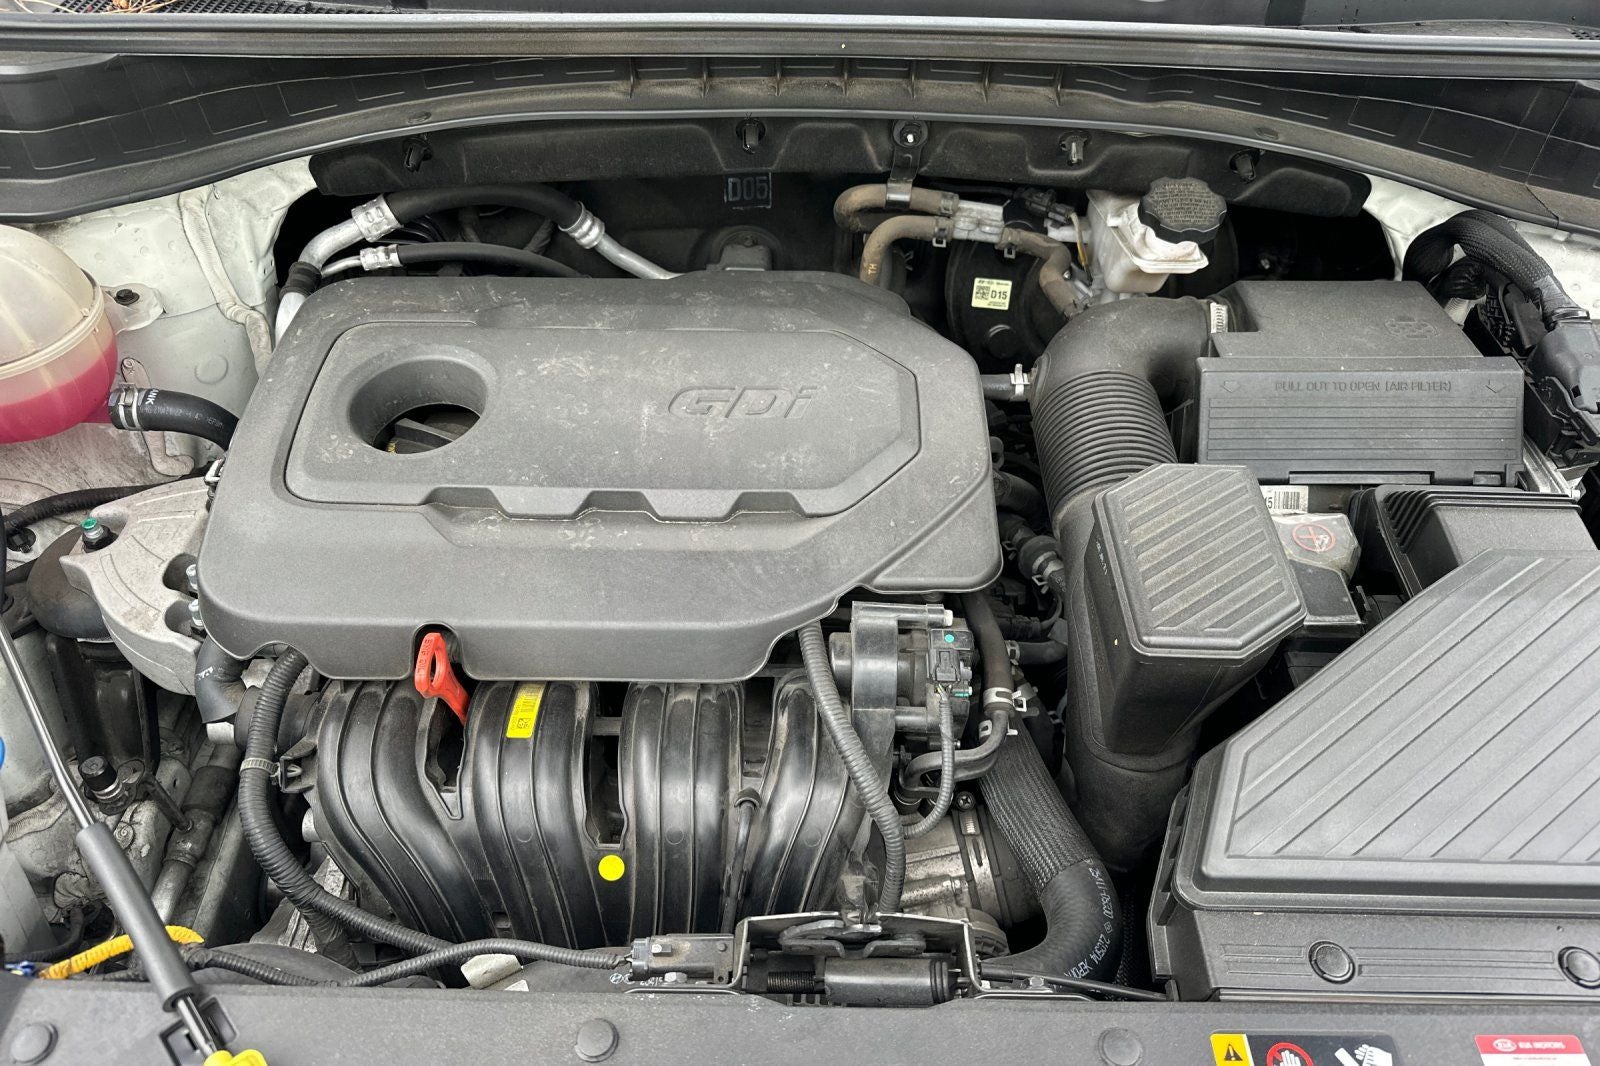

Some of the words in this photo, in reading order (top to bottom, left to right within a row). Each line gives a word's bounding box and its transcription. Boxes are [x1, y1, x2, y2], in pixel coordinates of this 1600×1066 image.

[727, 176, 769, 202] D05
[990, 290, 1008, 301] D15
[1274, 380, 1302, 393] PULL
[1306, 380, 1328, 393] OUT
[1332, 380, 1348, 393] TO
[1350, 380, 1380, 393] OPEN
